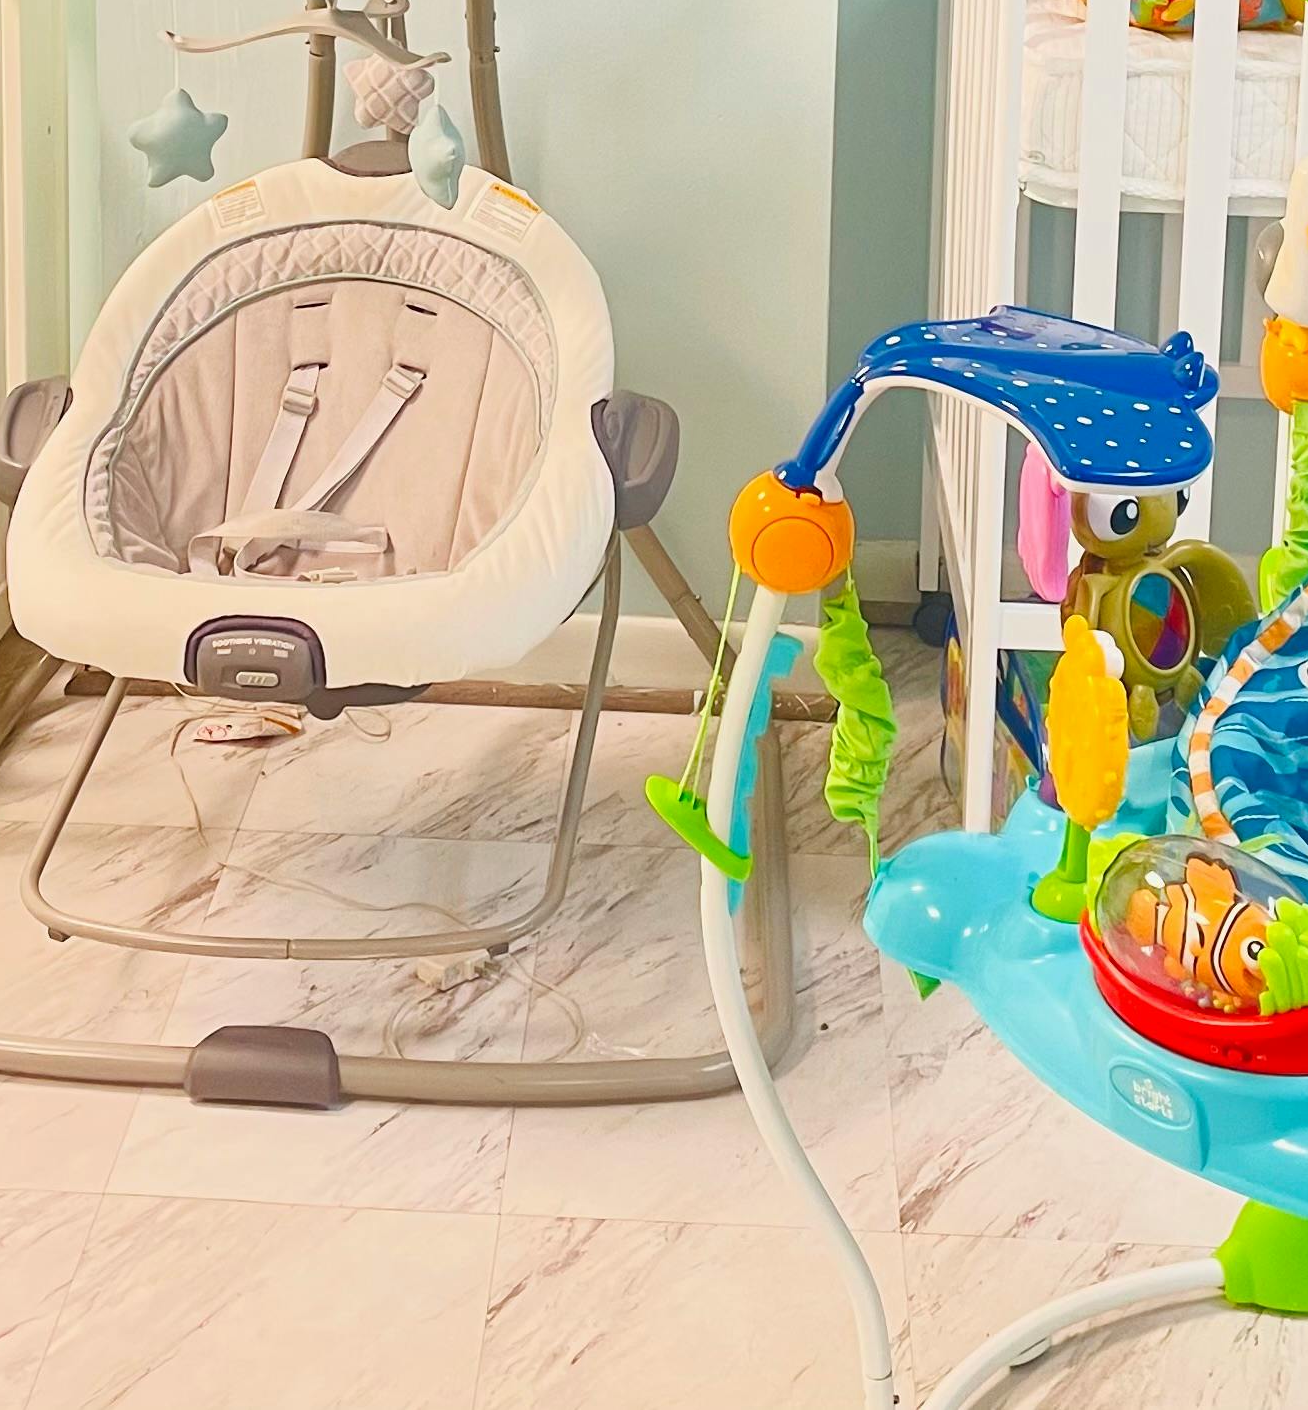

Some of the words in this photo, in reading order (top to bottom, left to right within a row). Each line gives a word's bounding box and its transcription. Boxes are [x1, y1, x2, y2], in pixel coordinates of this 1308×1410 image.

[212, 637, 253, 648] SOOTHING
[254, 638, 296, 651] VIBRATION
[1133, 1078, 1171, 1106] bright
[1133, 1094, 1174, 1120] starts
